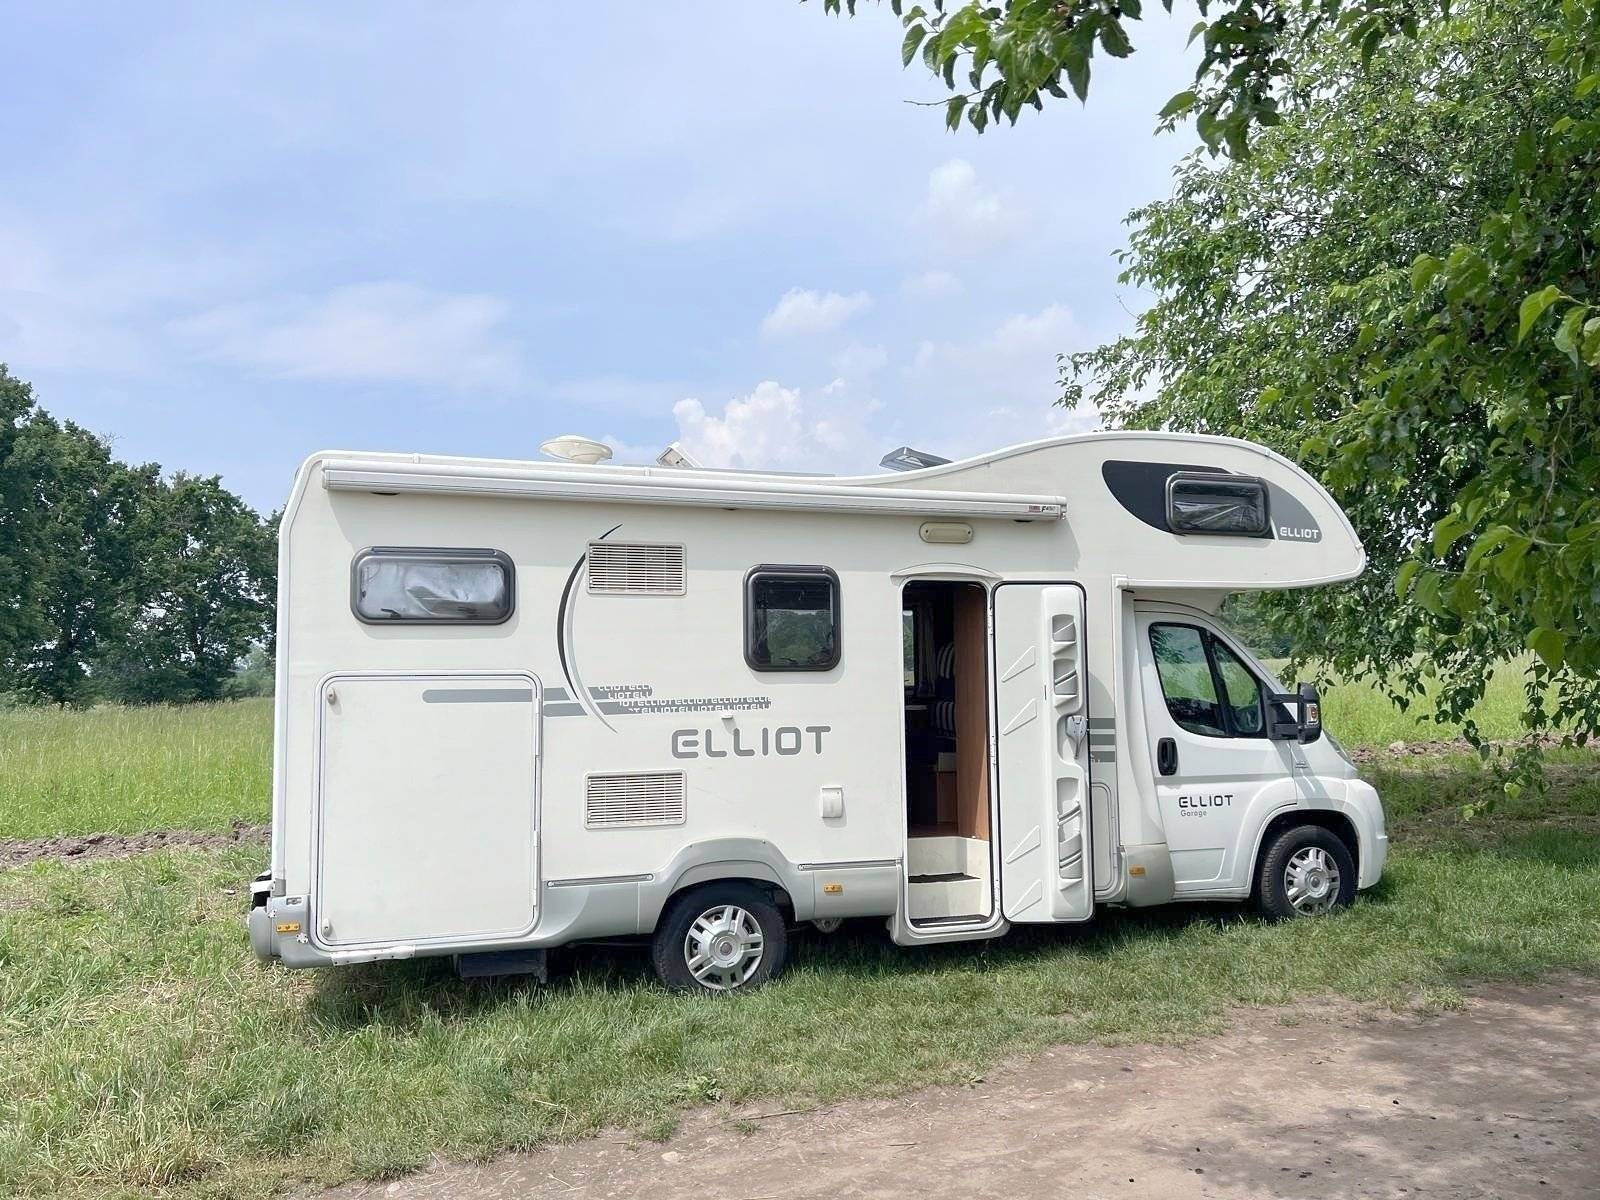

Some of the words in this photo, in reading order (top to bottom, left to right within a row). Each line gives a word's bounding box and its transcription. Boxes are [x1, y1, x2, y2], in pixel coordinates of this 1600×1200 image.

[1280, 527, 1319, 539] ELLIOT
[672, 726, 832, 759] ELLIOT
[1179, 795, 1233, 808] ELLIOT
[1180, 810, 1207, 818] Garage
